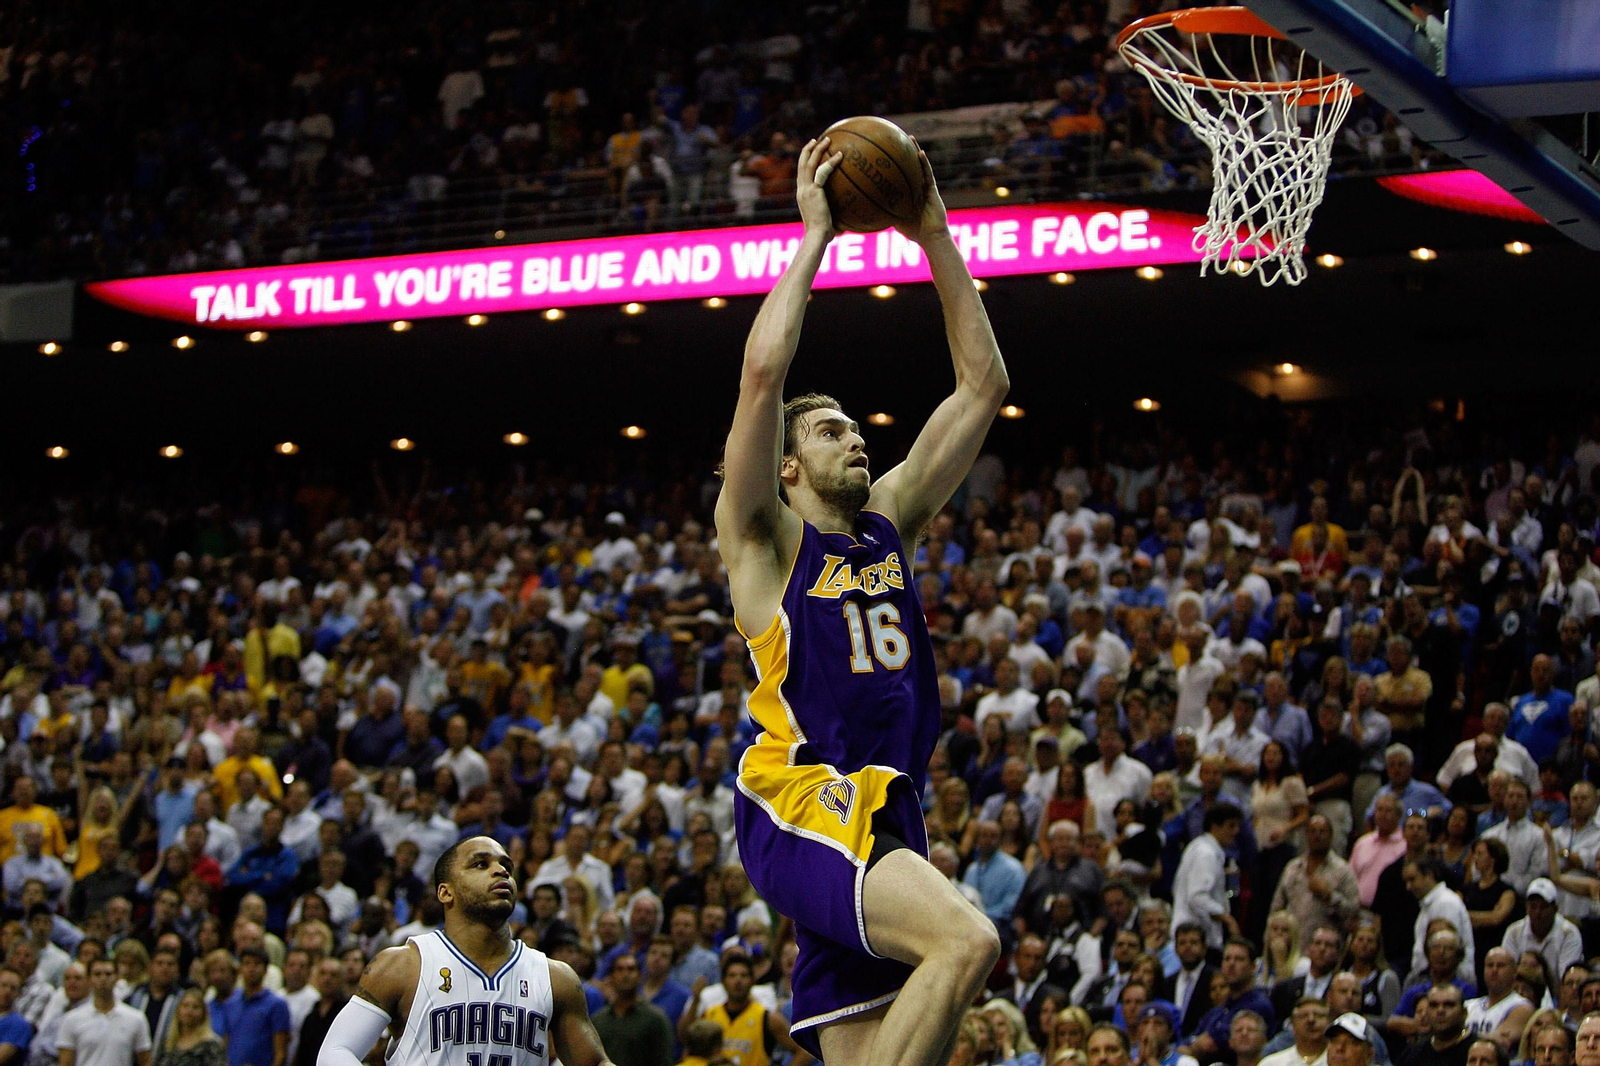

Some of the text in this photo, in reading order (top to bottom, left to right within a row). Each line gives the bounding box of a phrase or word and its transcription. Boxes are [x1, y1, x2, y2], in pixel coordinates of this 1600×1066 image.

[191, 280, 281, 322] TALK
[289, 275, 366, 315] TILL
[374, 261, 513, 306] YOU'RE
[521, 251, 626, 296] BLUE
[632, 244, 721, 286] AND
[731, 233, 865, 279] WHTE
[875, 230, 921, 269] IN
[1032, 210, 1162, 257] FACE.
[842, 600, 911, 674] 16
[429, 1002, 548, 1058] MAGIC
